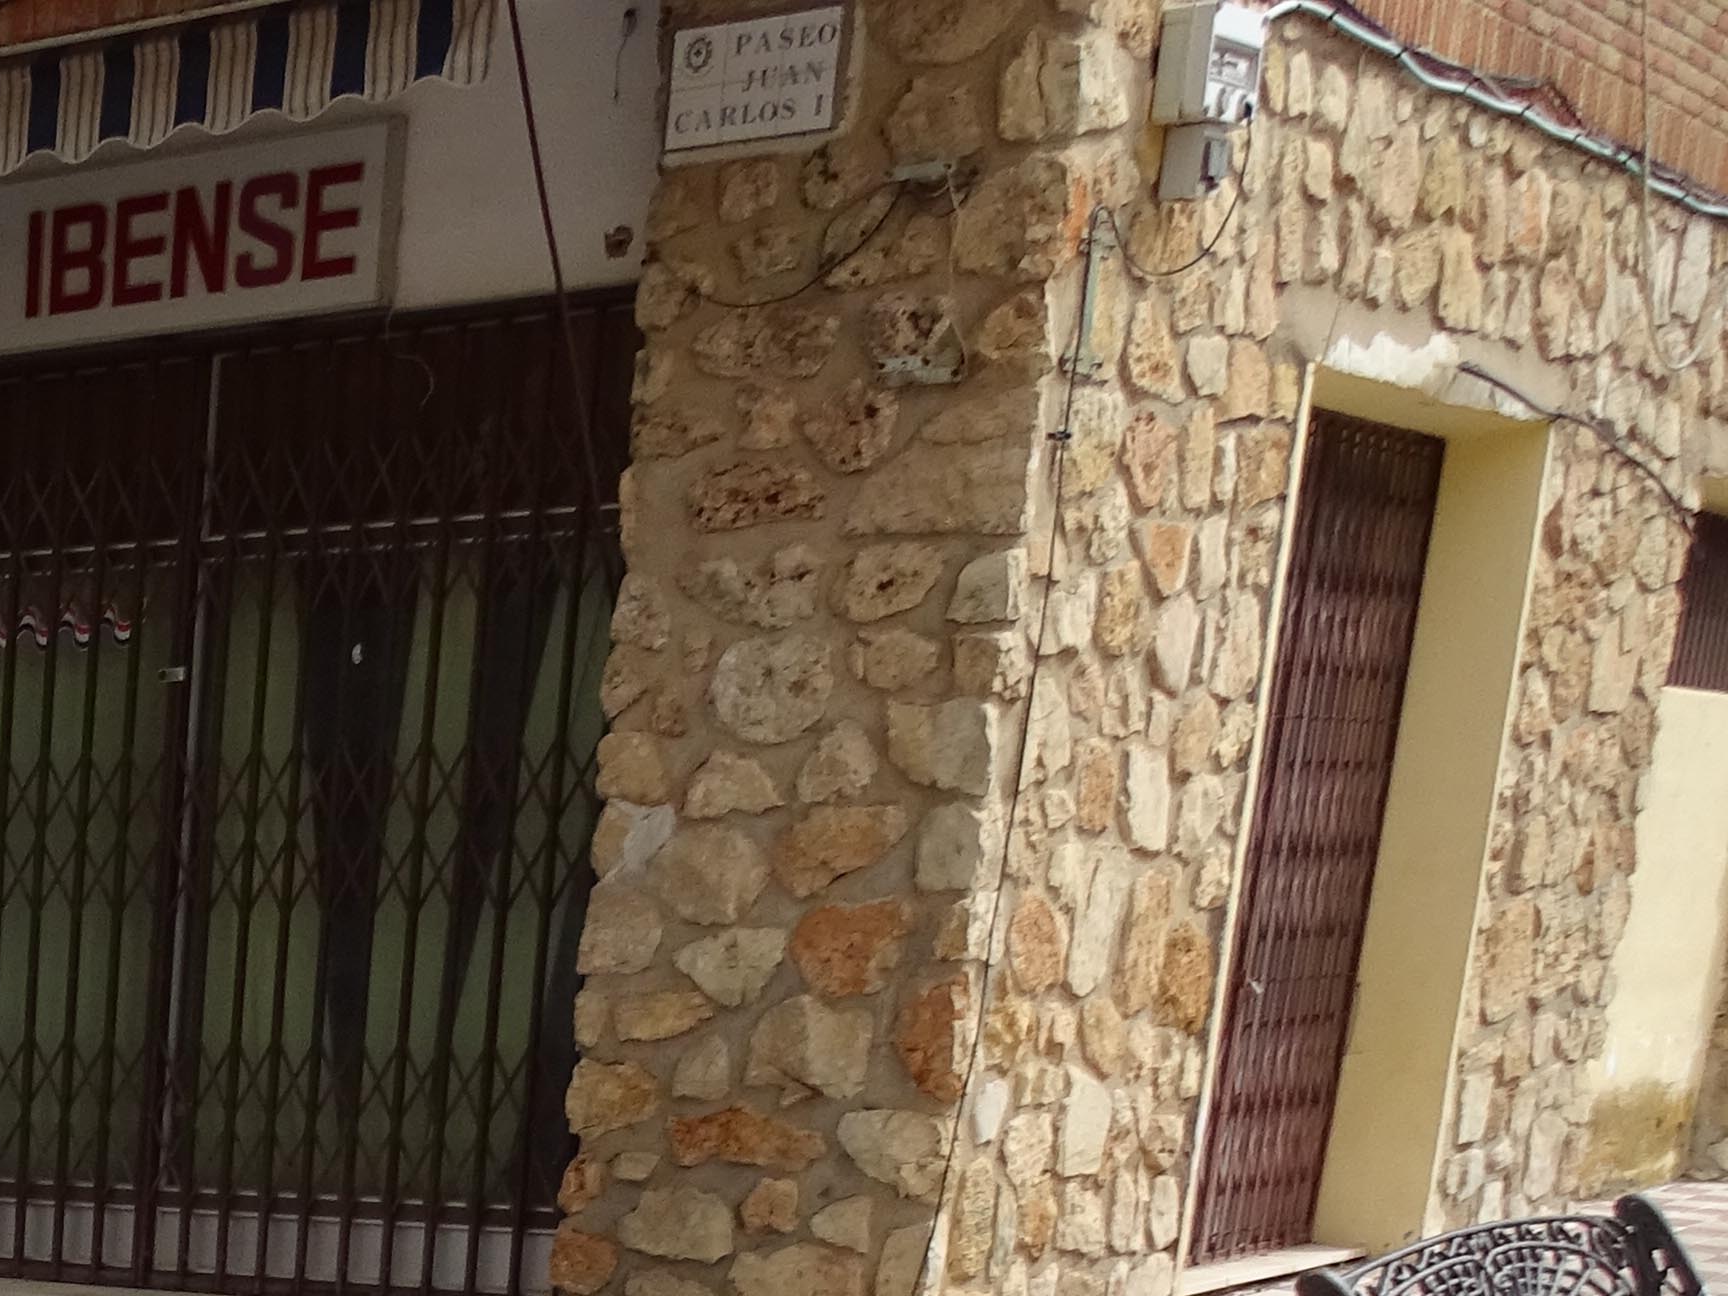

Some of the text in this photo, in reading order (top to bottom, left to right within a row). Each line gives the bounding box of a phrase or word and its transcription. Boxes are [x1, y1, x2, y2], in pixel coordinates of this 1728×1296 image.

[735, 23, 837, 56] PASEO
[742, 60, 825, 93] JUAN
[674, 94, 824, 134] CARLOS I
[25, 161, 365, 319] IBENSE
